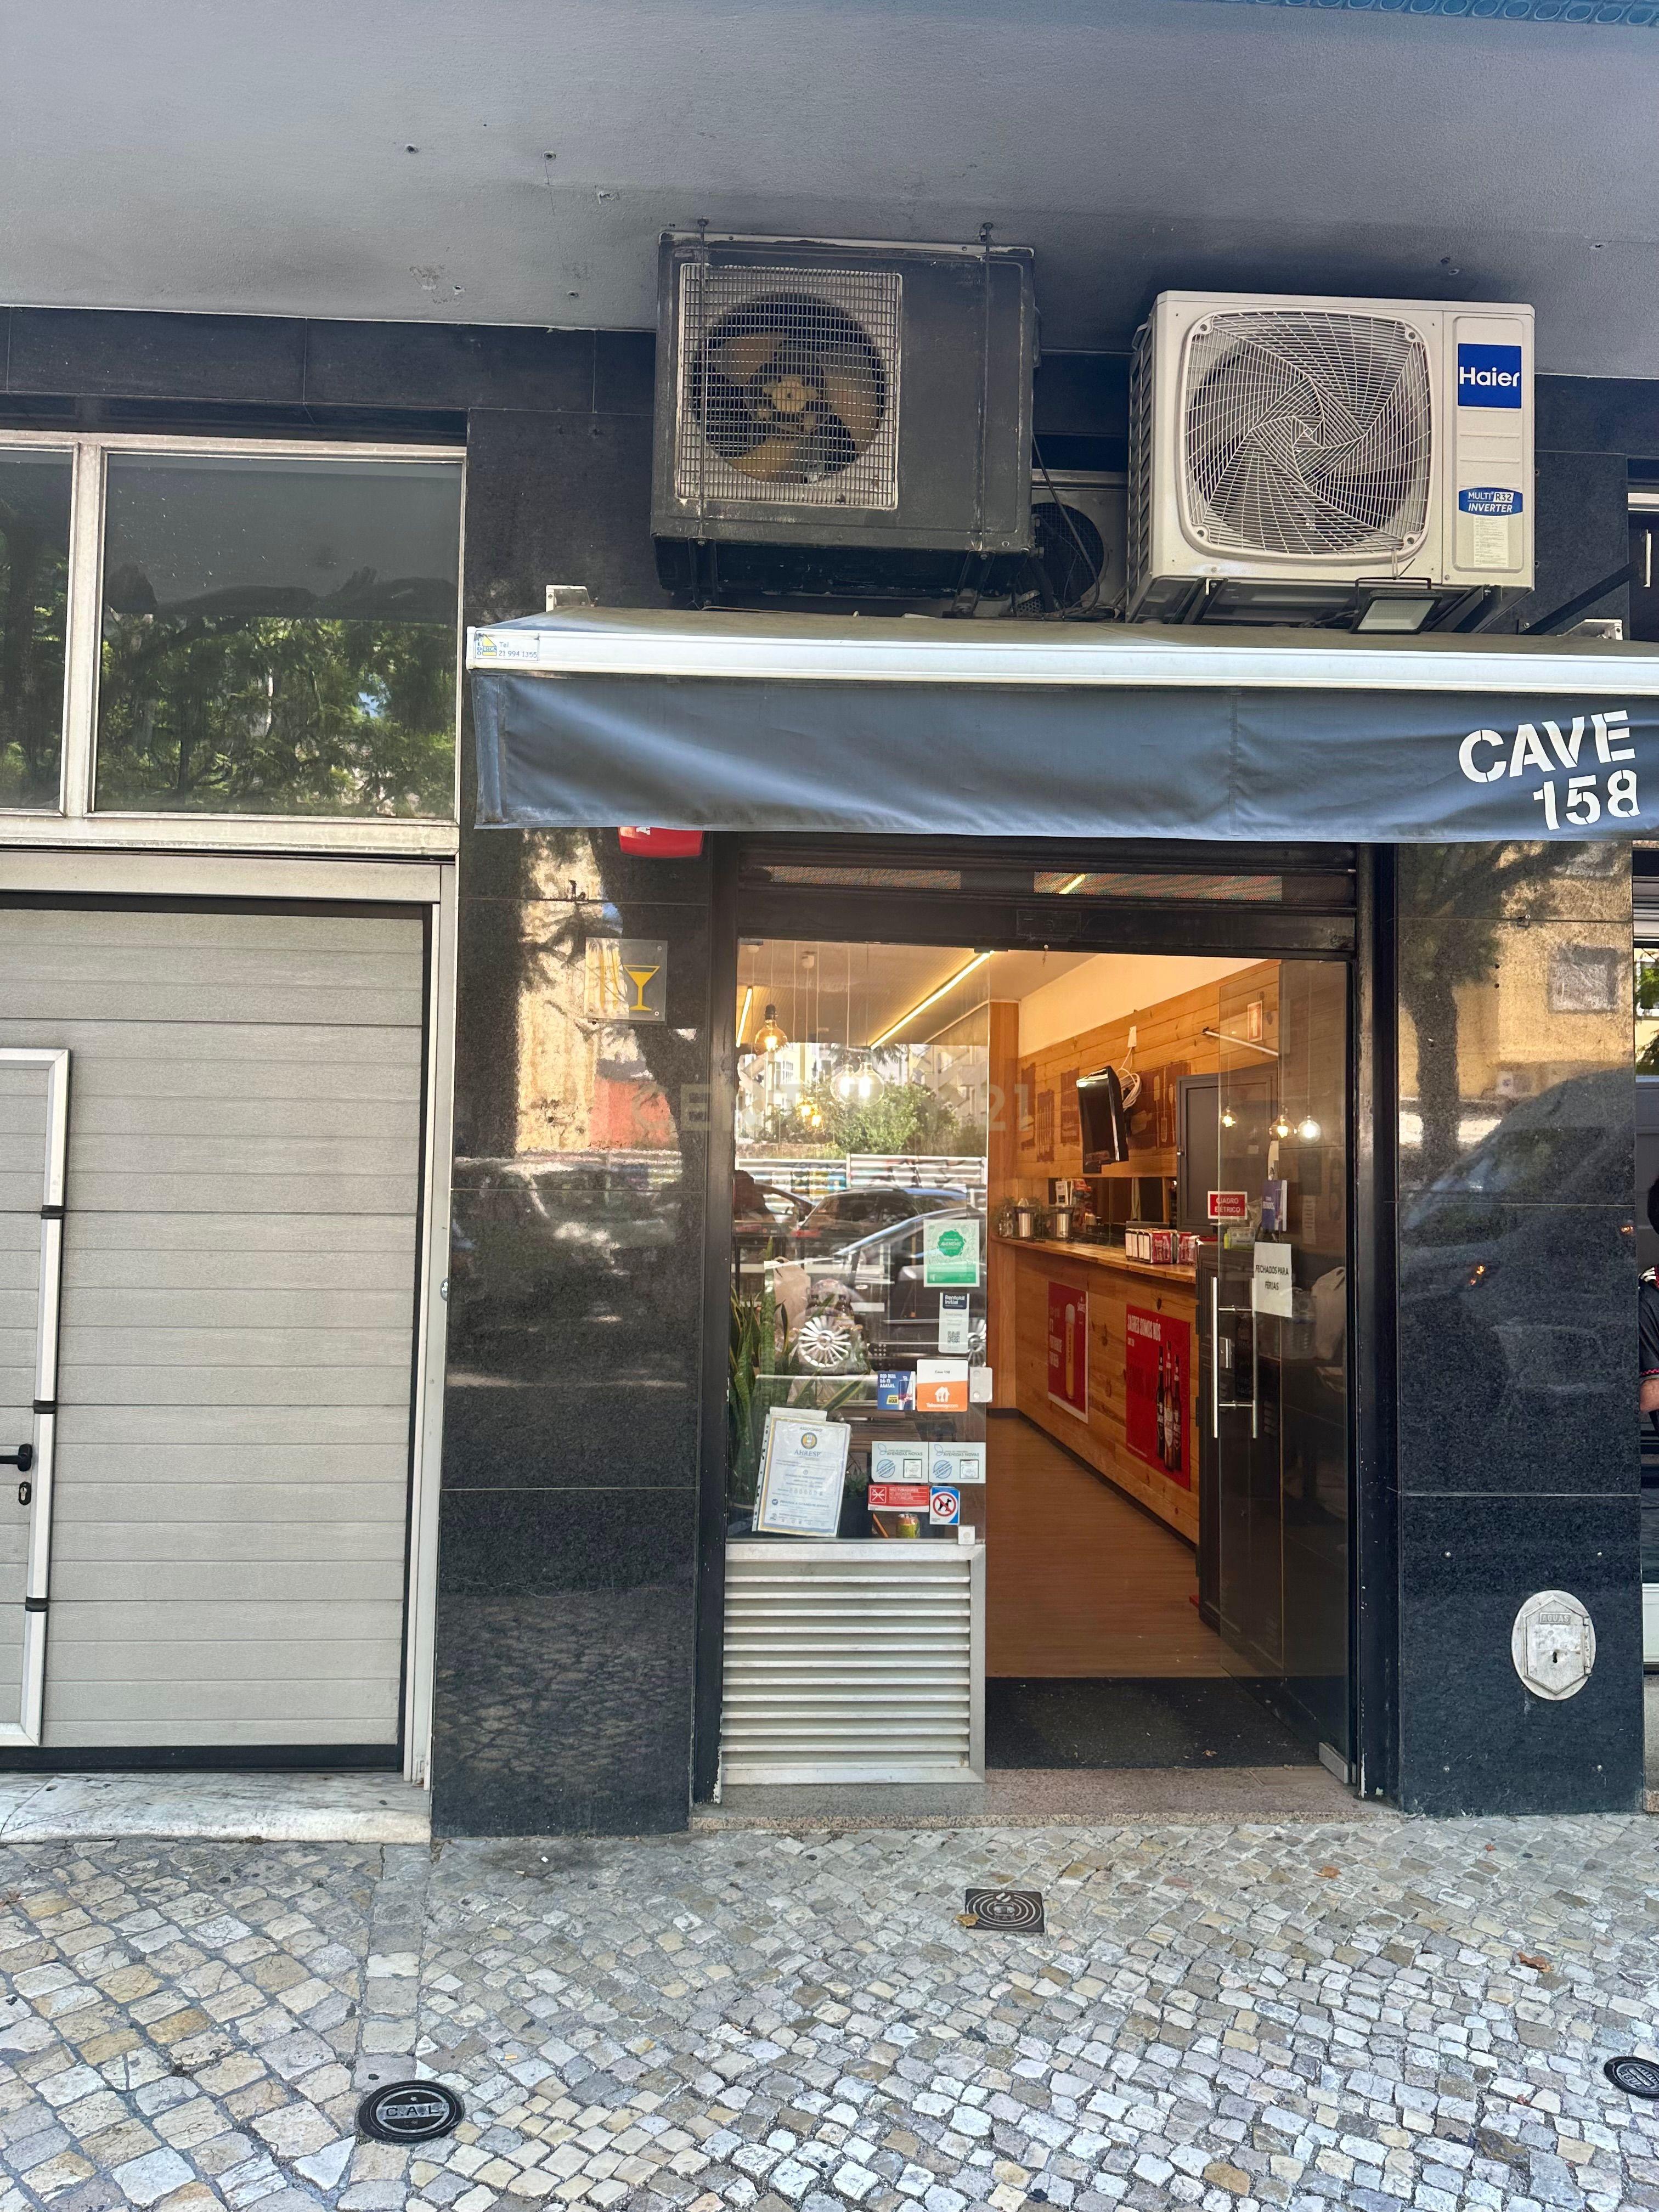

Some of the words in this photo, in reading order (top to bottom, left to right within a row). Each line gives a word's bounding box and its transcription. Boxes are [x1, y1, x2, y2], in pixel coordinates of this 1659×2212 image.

[1459, 366, 1520, 387] Haier
[1495, 493, 1512, 501] R32
[1468, 503, 1513, 513] INVERTER
[1459, 710, 1636, 783] CAVE
[1533, 769, 1641, 831] 158
[1255, 1265, 1278, 1274] FECHADOS
[1278, 1266, 1289, 1276] PARA
[1265, 1279, 1279, 1291] FÉRIAS
[794, 1449, 822, 1457] AHRESP
[1542, 1614, 1570, 1623] AGUAS
